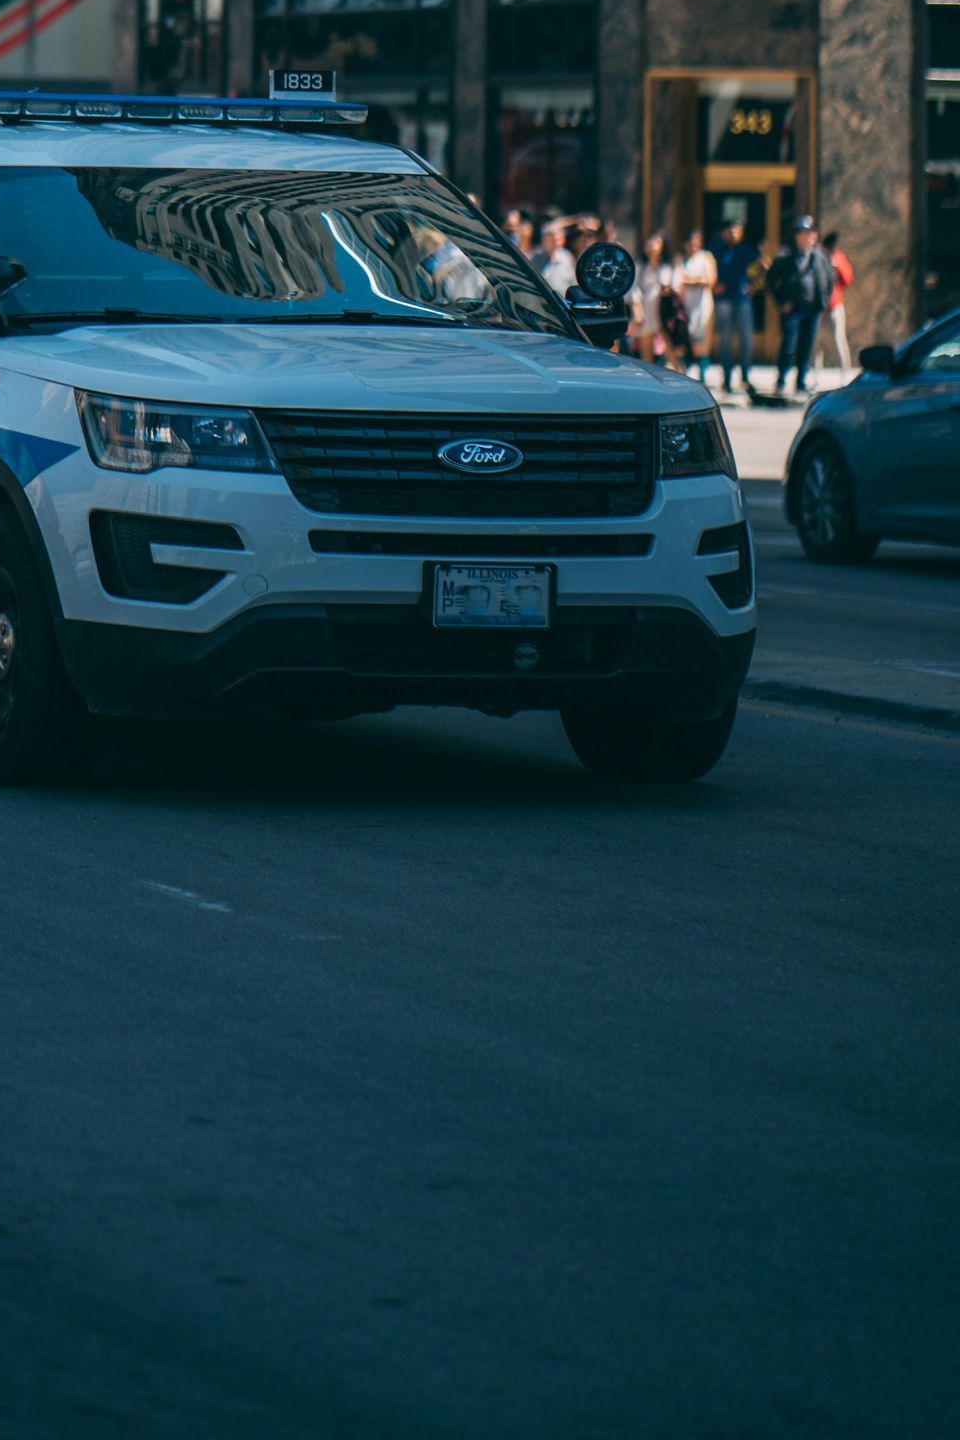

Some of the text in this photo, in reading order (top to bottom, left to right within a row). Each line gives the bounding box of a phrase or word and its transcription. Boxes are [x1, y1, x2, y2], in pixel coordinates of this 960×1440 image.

[284, 73, 322, 89] 1833
[460, 443, 506, 463] Ford
[467, 568, 519, 580] ILLINOIS
